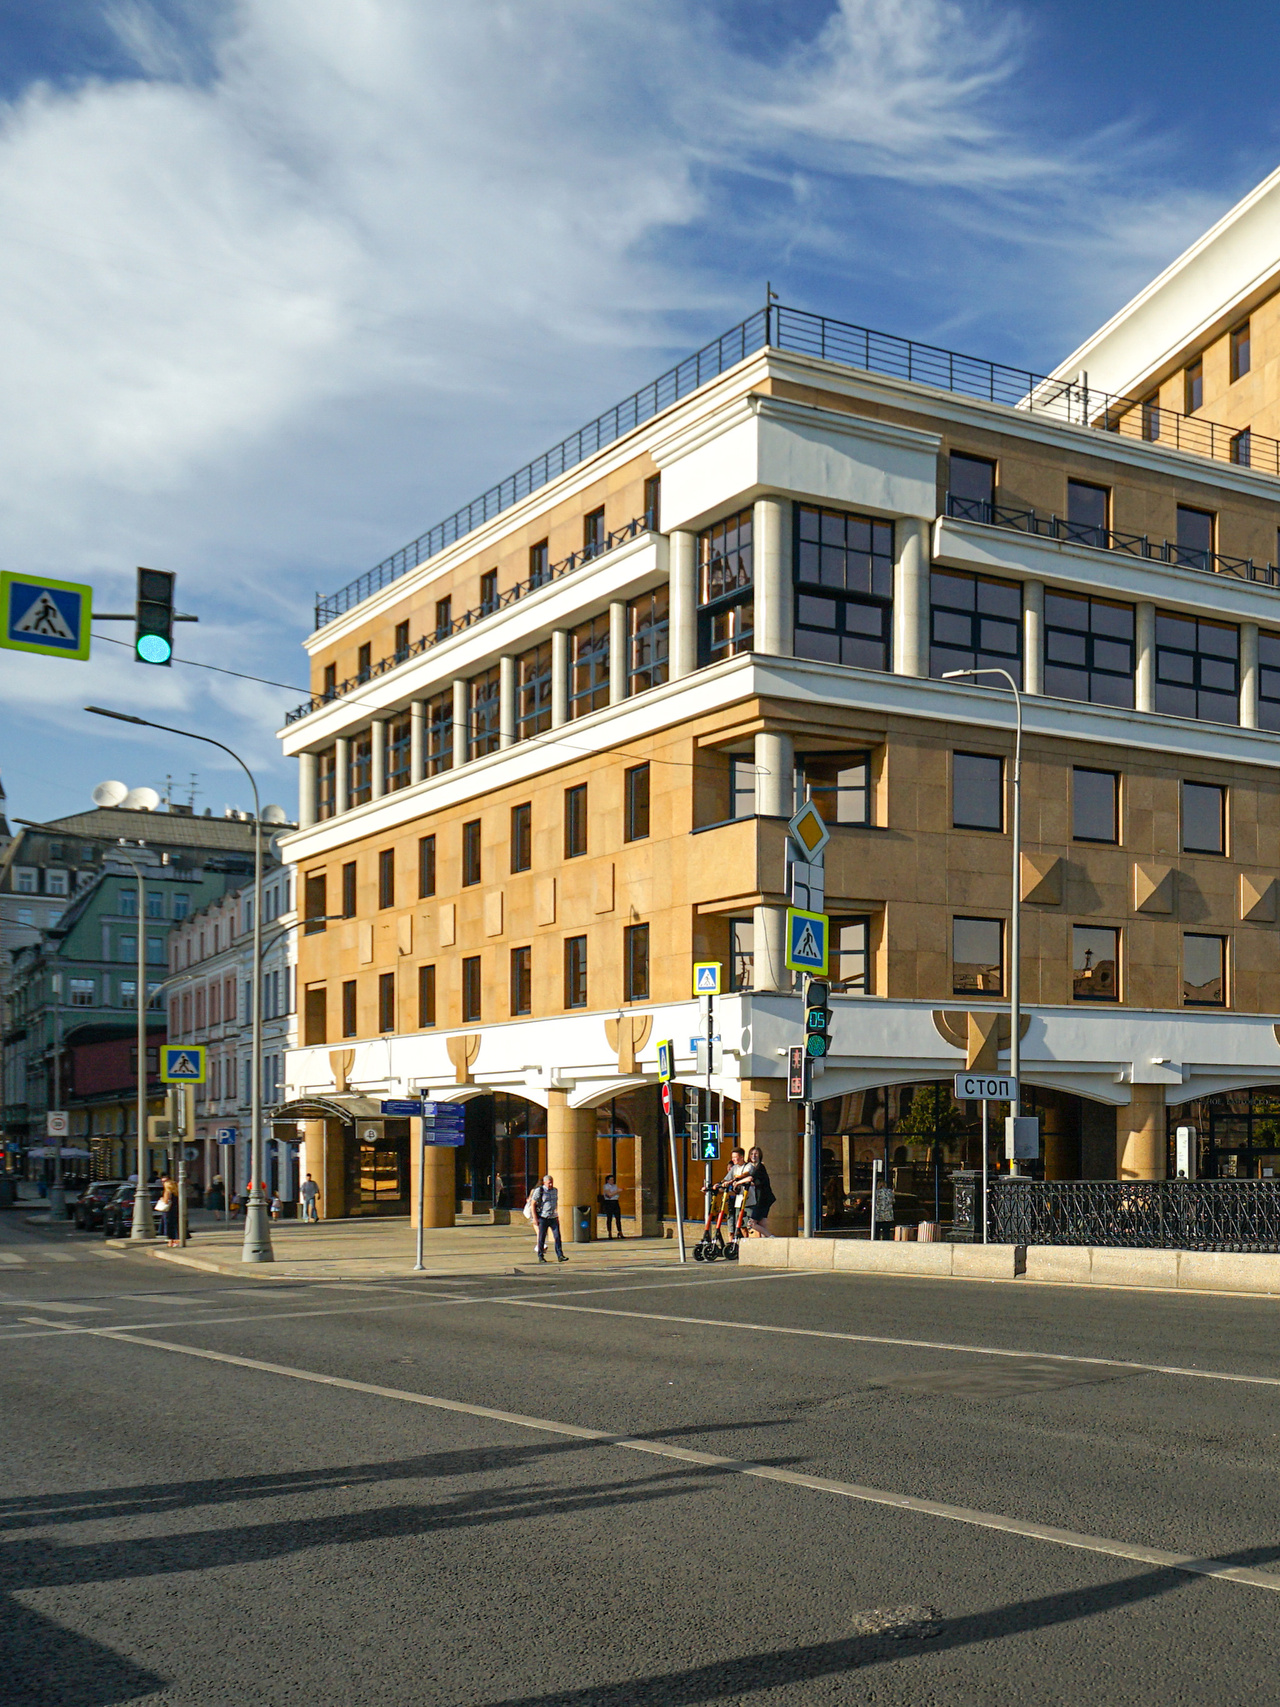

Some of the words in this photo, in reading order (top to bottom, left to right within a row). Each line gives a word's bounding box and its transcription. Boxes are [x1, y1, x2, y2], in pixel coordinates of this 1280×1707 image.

[809, 1011, 825, 1028] 05
[965, 1079, 1009, 1096] СТОП
[219, 1130, 230, 1143] P
[702, 1124, 718, 1140] 34
